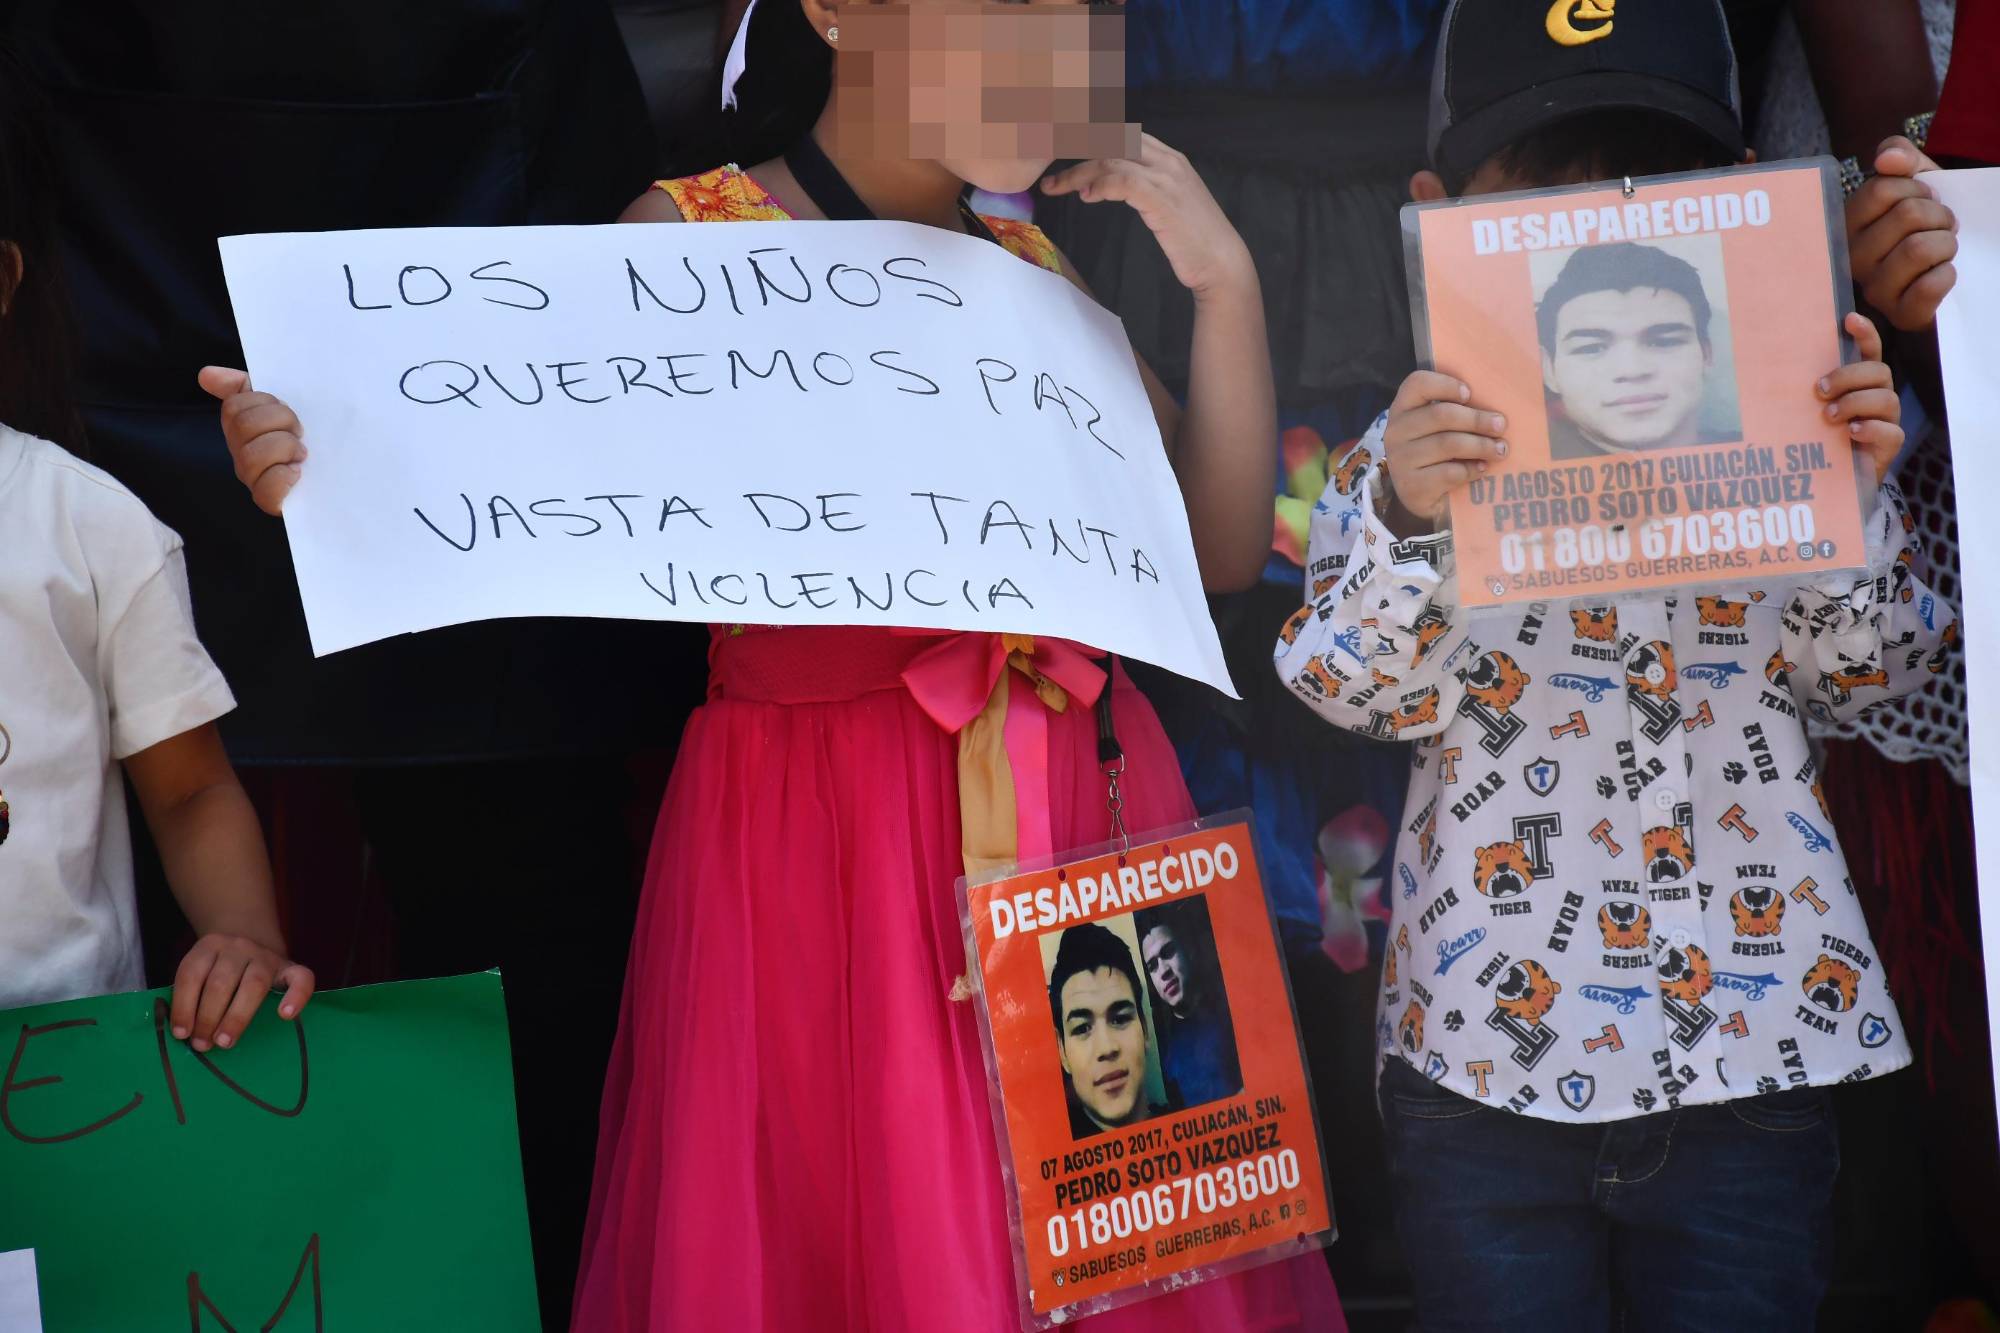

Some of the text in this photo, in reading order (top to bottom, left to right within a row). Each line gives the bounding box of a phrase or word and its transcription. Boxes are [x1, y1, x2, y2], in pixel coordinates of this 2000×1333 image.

[1472, 189, 1771, 256] DESAPARECIDO
[343, 247, 962, 314] LOS NIÑOS
[400, 351, 1125, 461] QUEREMOS PAZ
[1469, 441, 1833, 505] 07 AGOSTO 2017 CULIACÁN, SIN.
[1493, 472, 1815, 532] PEDRO SOTO VAZQUEZ
[414, 492, 1159, 583] VASTA DE TANTA
[1500, 533, 1545, 575] 01
[1554, 523, 1632, 569] 800
[1639, 503, 1816, 560] 6703600
[640, 562, 1034, 611] VIOLENCIA
[1511, 547, 1795, 591] SABUESOS GUERRERAS, A.C.
[1699, 631, 1749, 645] TIGERS
[1450, 771, 1506, 823] ROAR
[989, 841, 1240, 940] DESAPARECIDO
[1602, 880, 1640, 894] TEAM
[1649, 887, 1691, 901] TIGER
[1736, 864, 1777, 878] TEAM
[1419, 887, 1460, 935] ROAR
[1490, 901, 1533, 916] TIGER
[1548, 890, 1584, 953] ROAR
[1602, 954, 1653, 969] TIGERS
[1732, 942, 1785, 957] TIGERS
[1821, 934, 1871, 970] TIGERS
[1795, 1005, 1839, 1035] TEAM
[1040, 1095, 1287, 1181] 07 AGOSTO 2017, CULIACÁN, SIN.
[1055, 1122, 1281, 1209] PEDRO SOTO VAZQUEZ
[1047, 1148, 1300, 1258] 018006703600
[1069, 1208, 1275, 1284] SABUESOS GUERRERAS, A.C.
